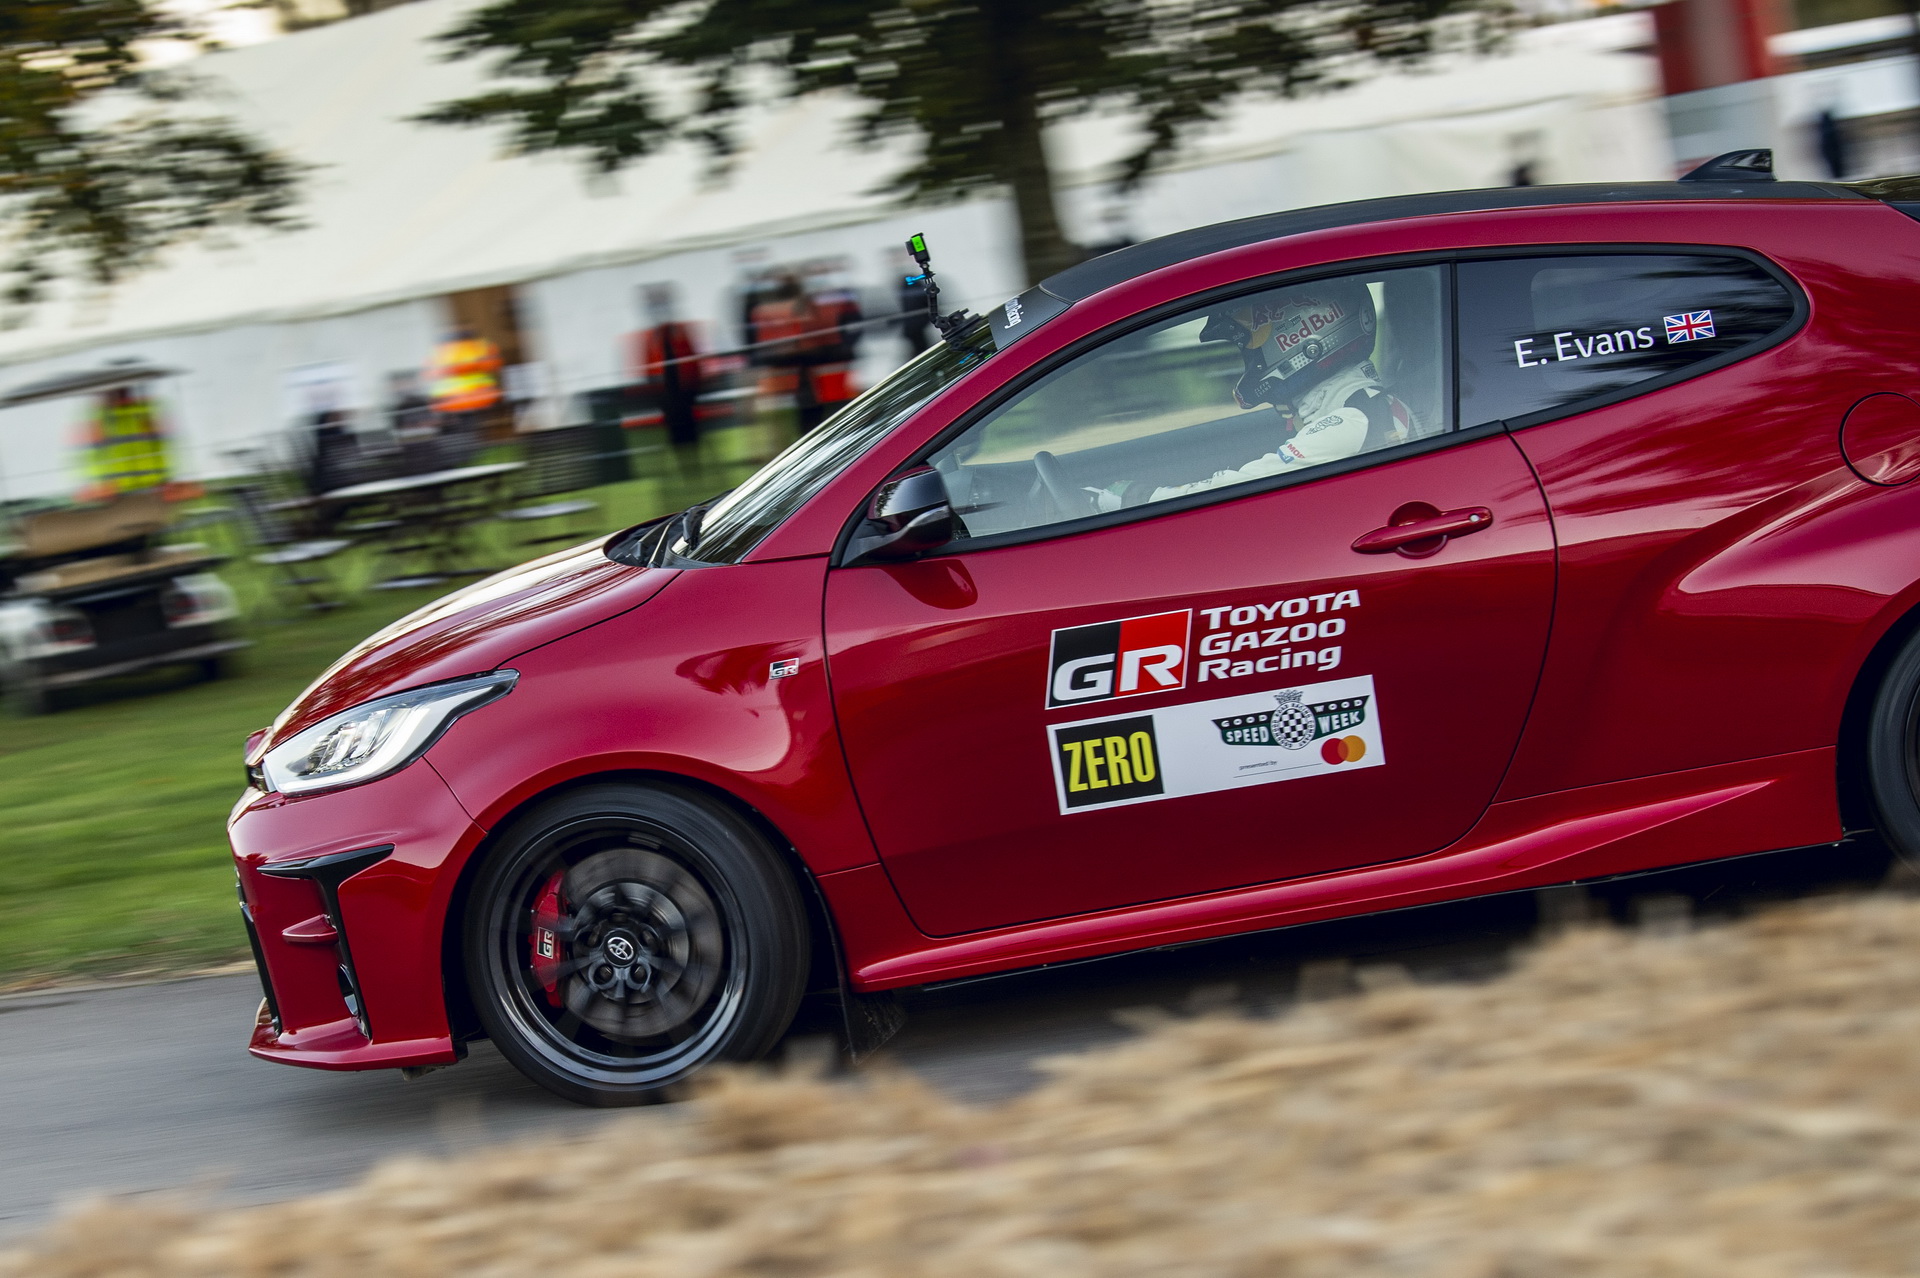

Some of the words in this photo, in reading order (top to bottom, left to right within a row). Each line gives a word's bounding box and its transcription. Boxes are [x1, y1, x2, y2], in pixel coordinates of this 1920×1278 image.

[1275, 319, 1313, 352] Red
[1308, 300, 1345, 332] Bull
[1514, 338, 1548, 368] E.
[1553, 326, 1654, 362] Evans
[1200, 589, 1361, 630] TOYOTA
[1199, 618, 1346, 656] GAZOO
[772, 665, 797, 677] GR
[1052, 644, 1183, 701] GR
[1197, 646, 1342, 683] Racing
[1221, 714, 1268, 728] GOOD
[1314, 699, 1363, 713] WOOD
[1226, 726, 1270, 743] SPEED
[1317, 710, 1361, 734] WEEK
[1062, 731, 1156, 793] ZERO
[543, 930, 553, 956] GR
